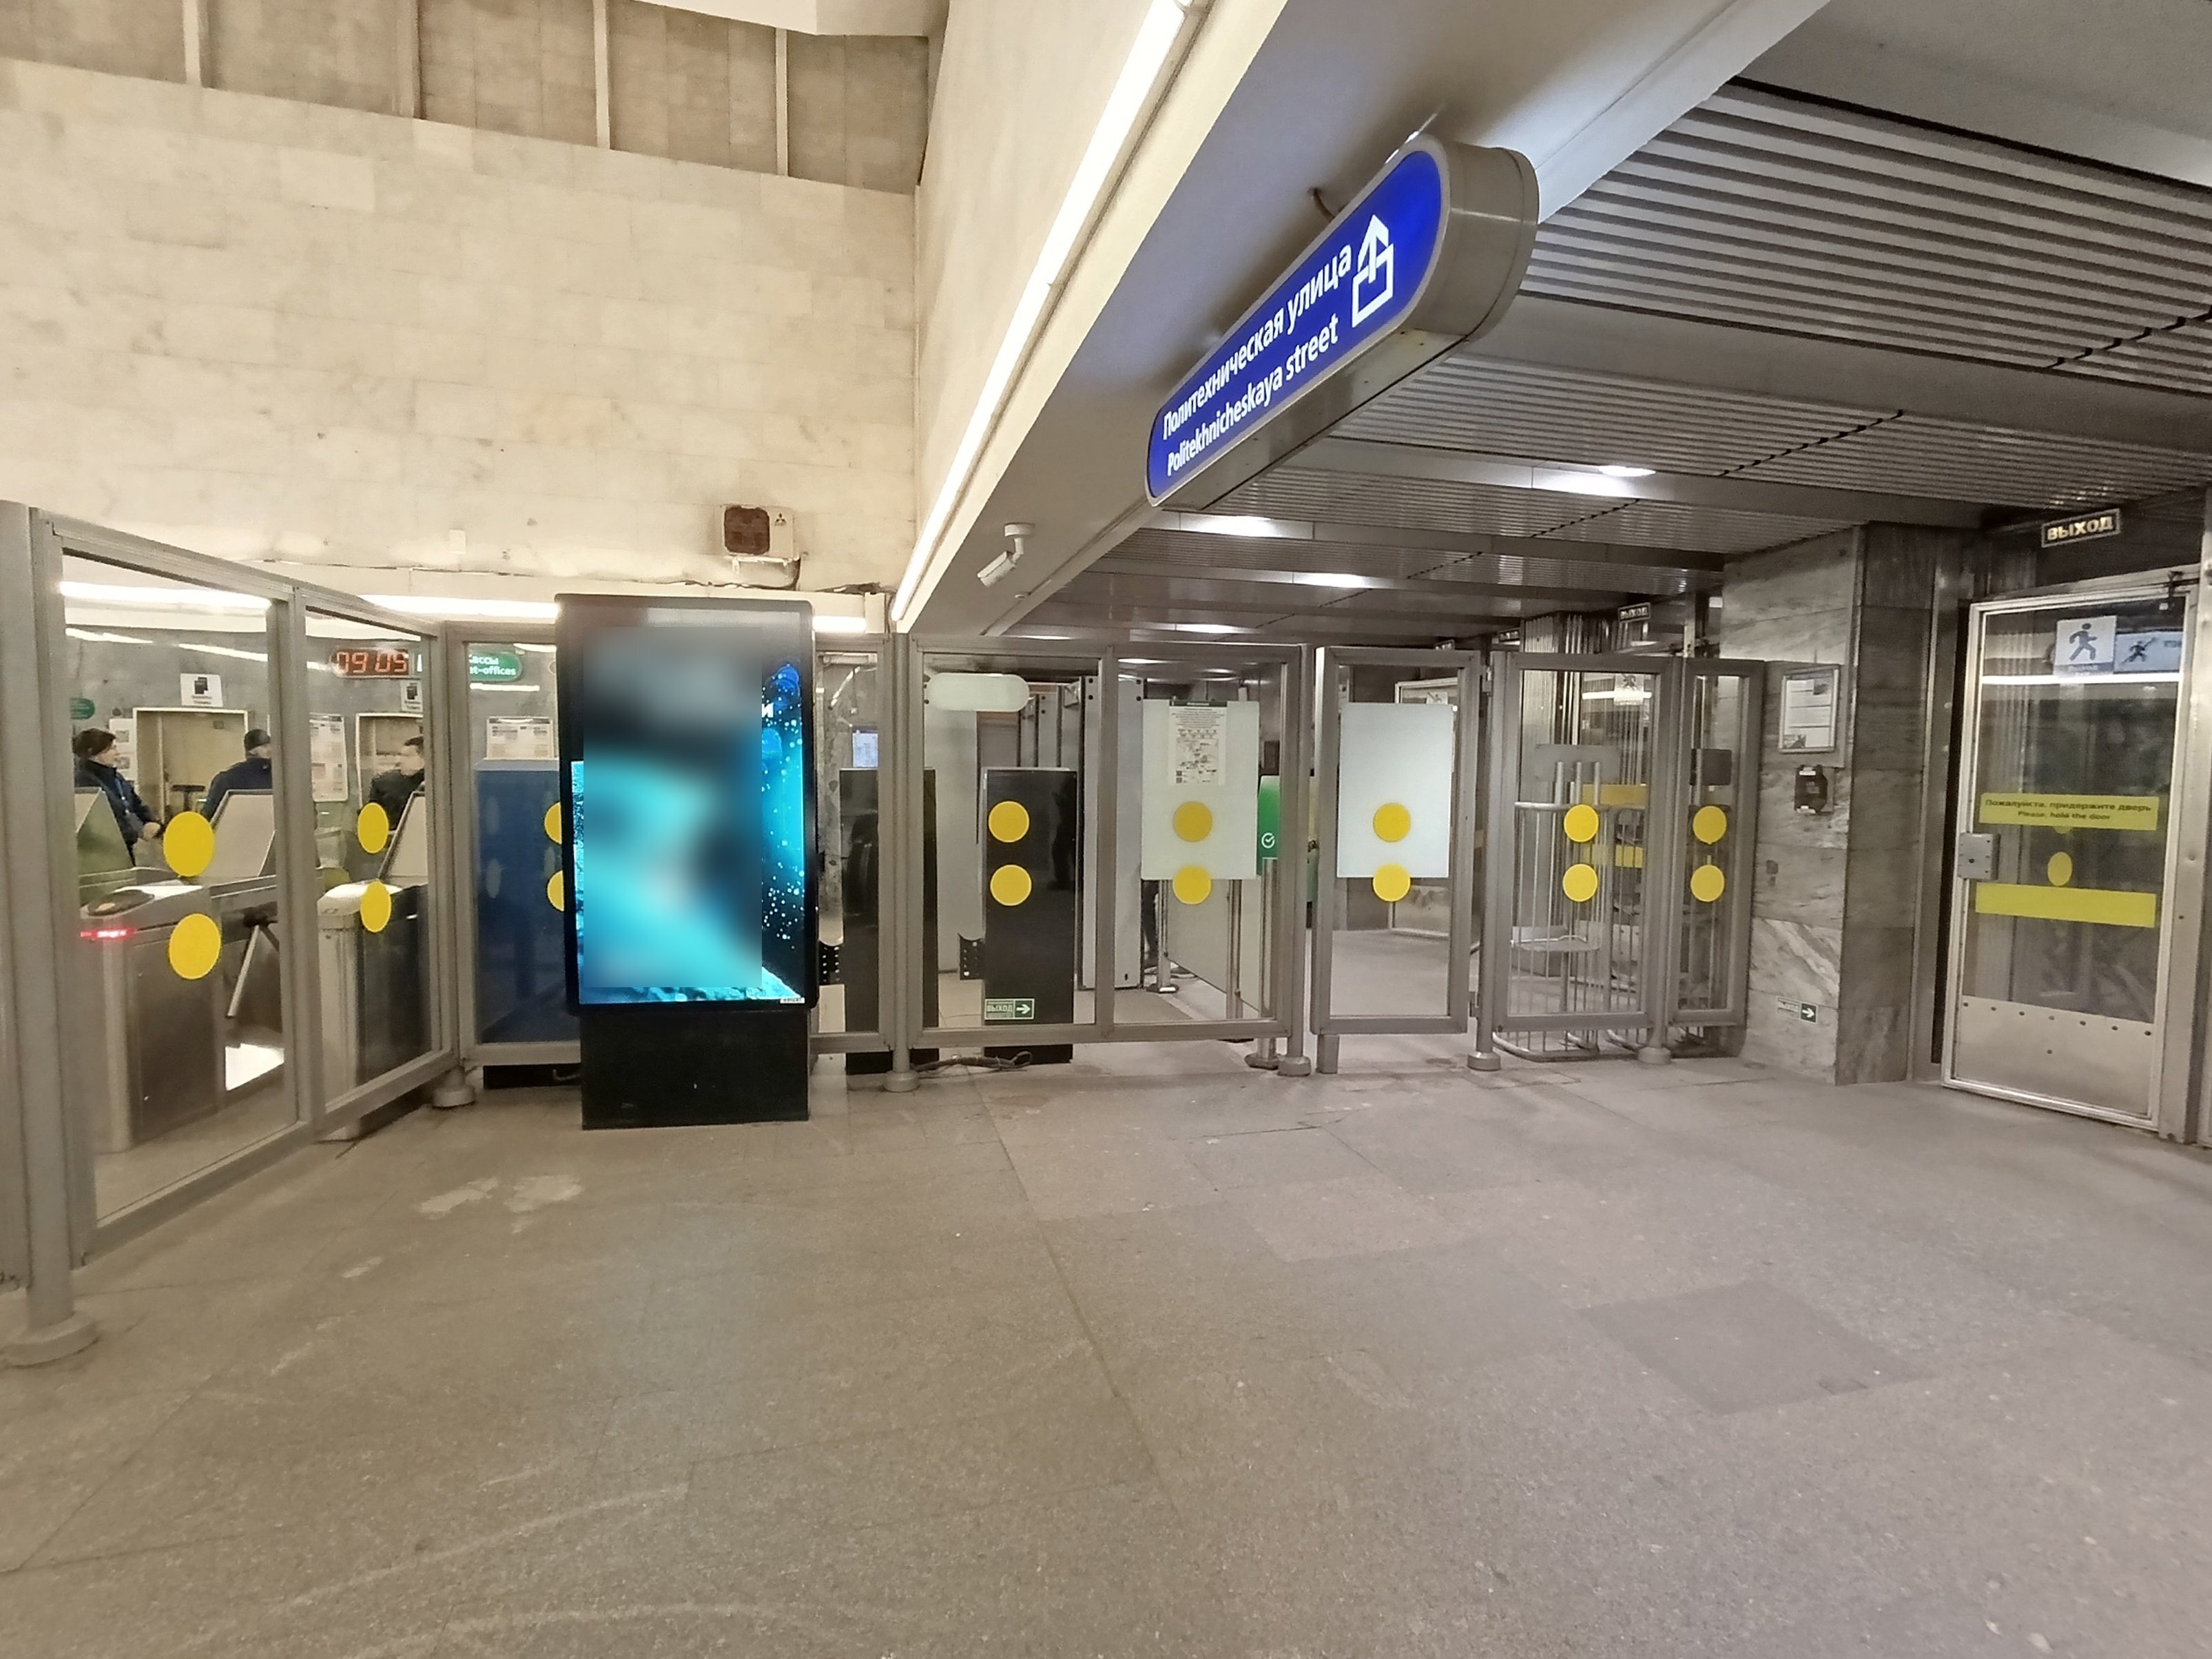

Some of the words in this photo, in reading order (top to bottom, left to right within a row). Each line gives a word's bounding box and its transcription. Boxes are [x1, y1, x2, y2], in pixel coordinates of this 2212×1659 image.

[1163, 308, 1285, 440] Политехническая
[1287, 244, 1352, 331] улица
[1167, 367, 1283, 476] Politekhnicheskaya
[1285, 313, 1338, 379] street
[2047, 517, 2113, 540] ВЫХОД
